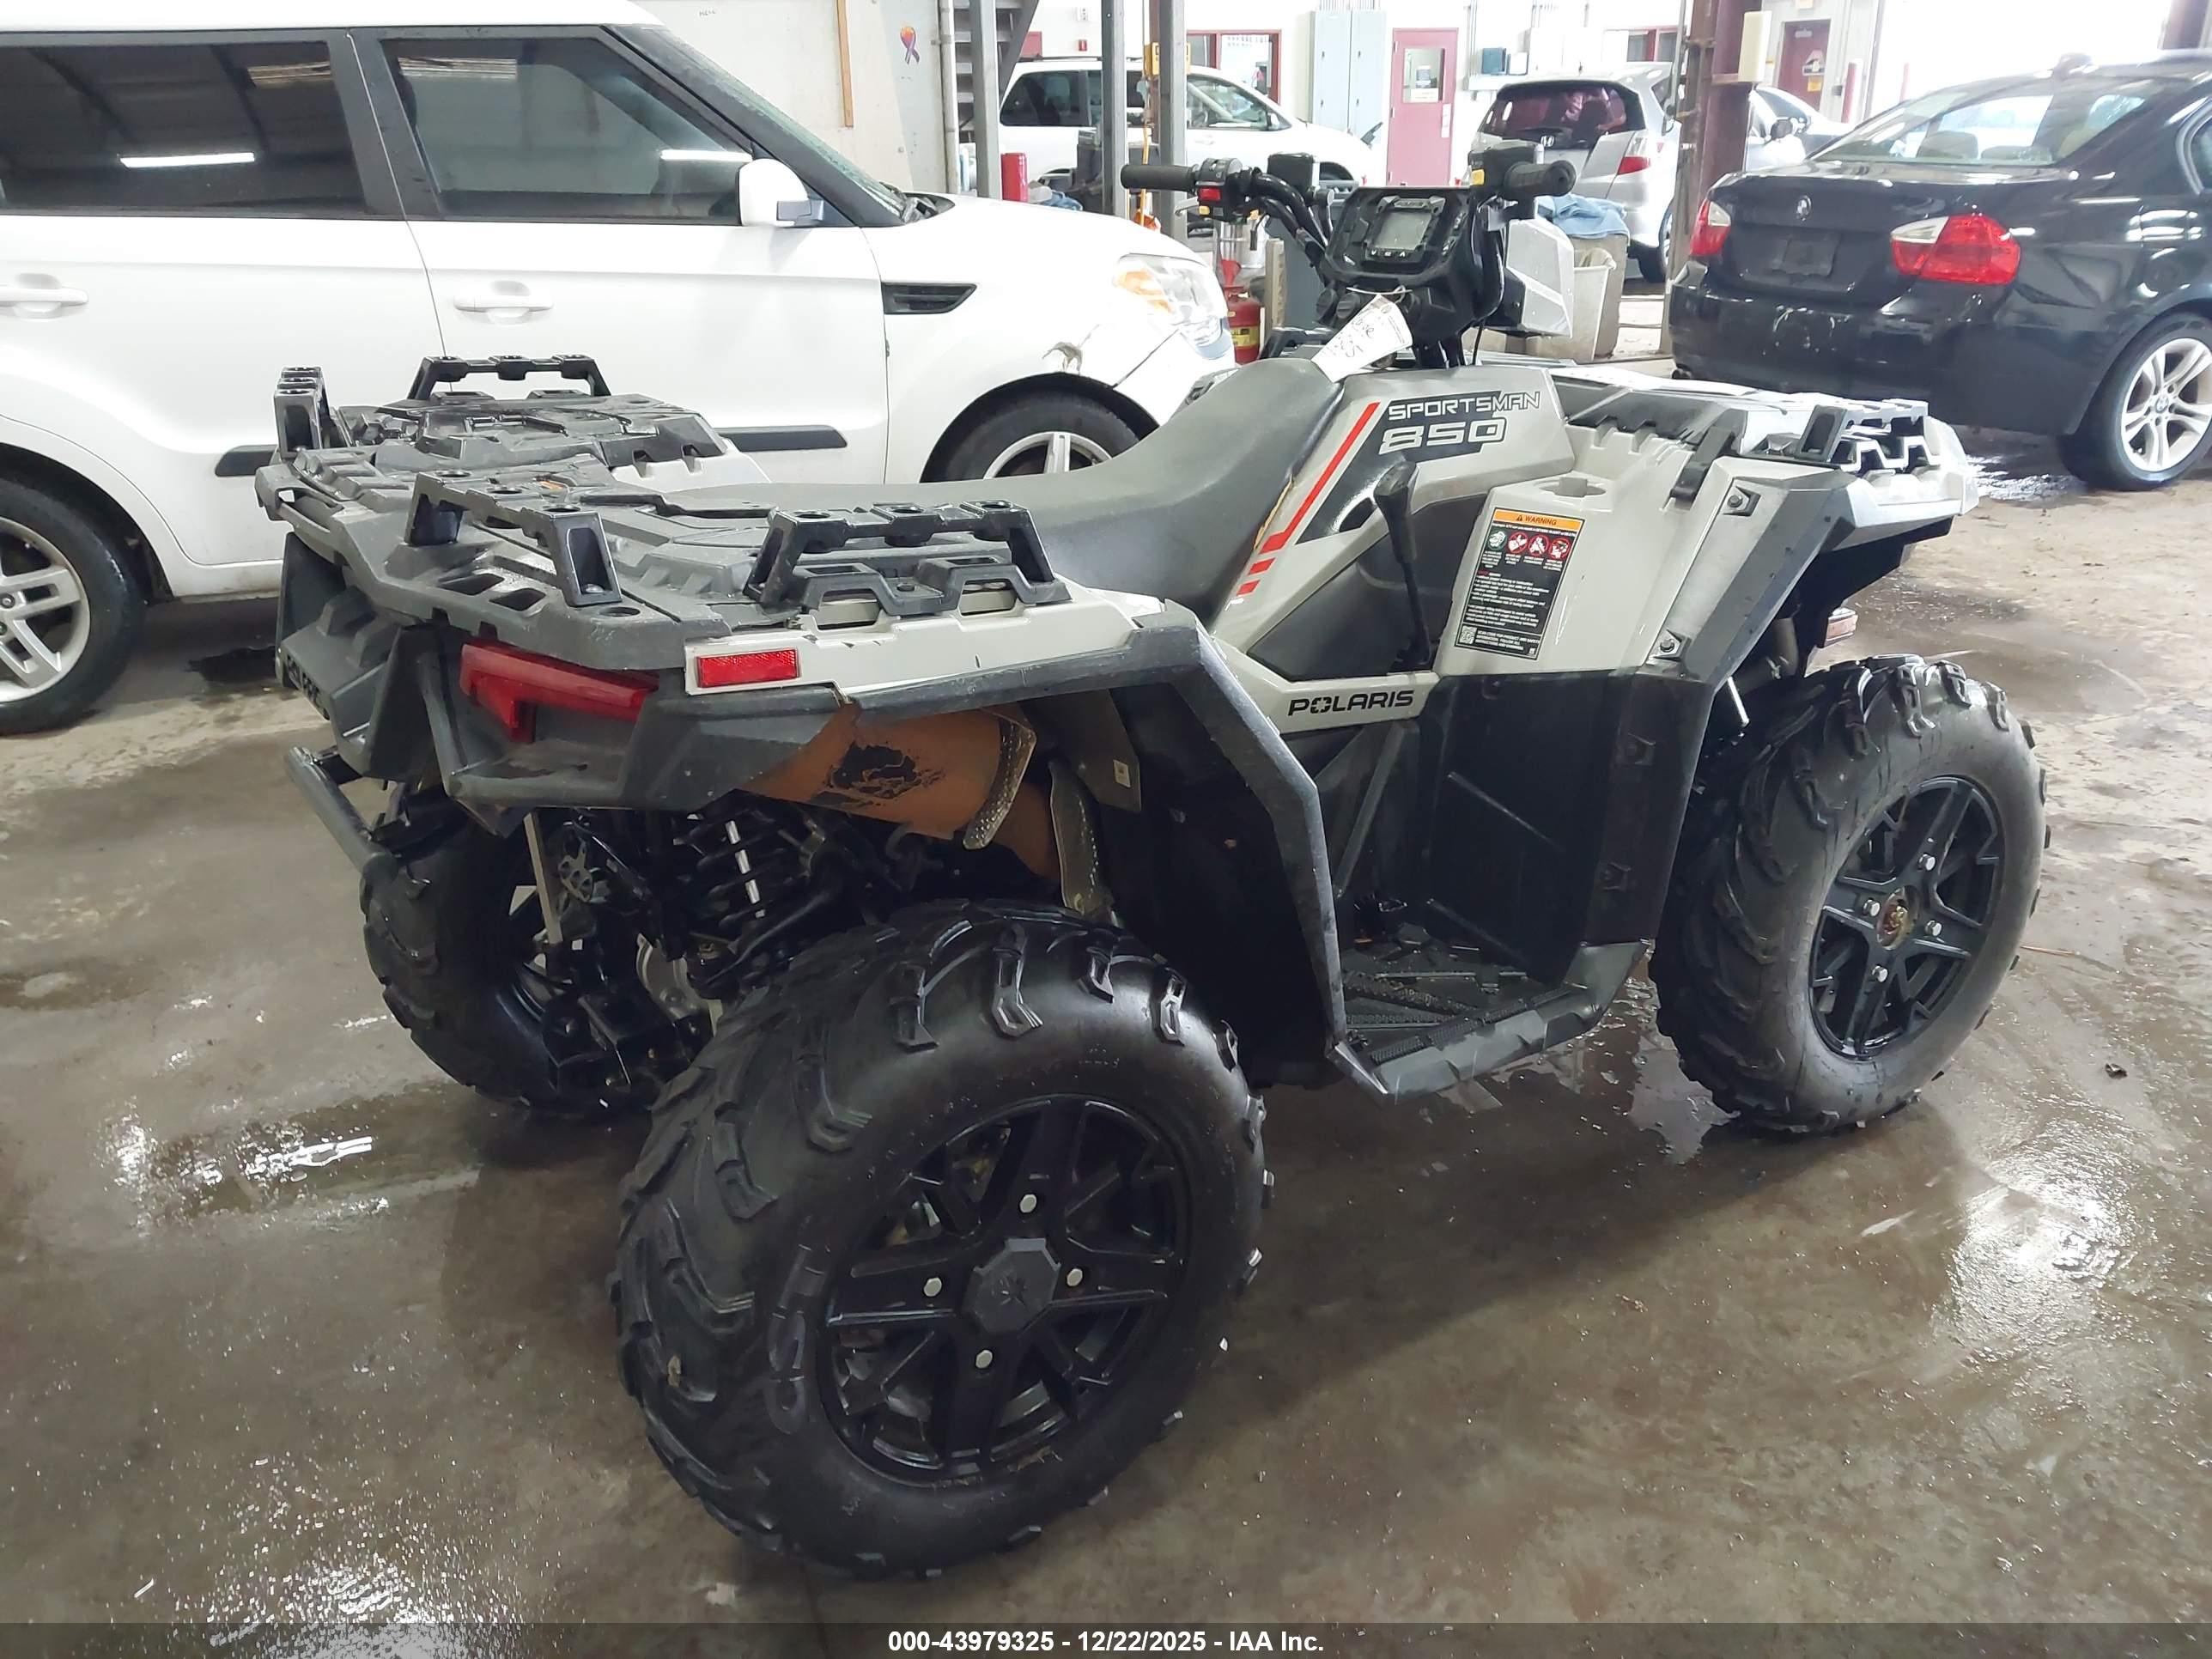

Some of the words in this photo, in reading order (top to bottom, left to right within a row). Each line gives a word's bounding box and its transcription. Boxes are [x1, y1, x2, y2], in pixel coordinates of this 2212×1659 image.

[1388, 391, 1540, 421] SPORTSMAN
[1377, 416, 1507, 455] 850
[1524, 514, 1557, 526] WARNING
[1288, 690, 1414, 716] POLARIS
